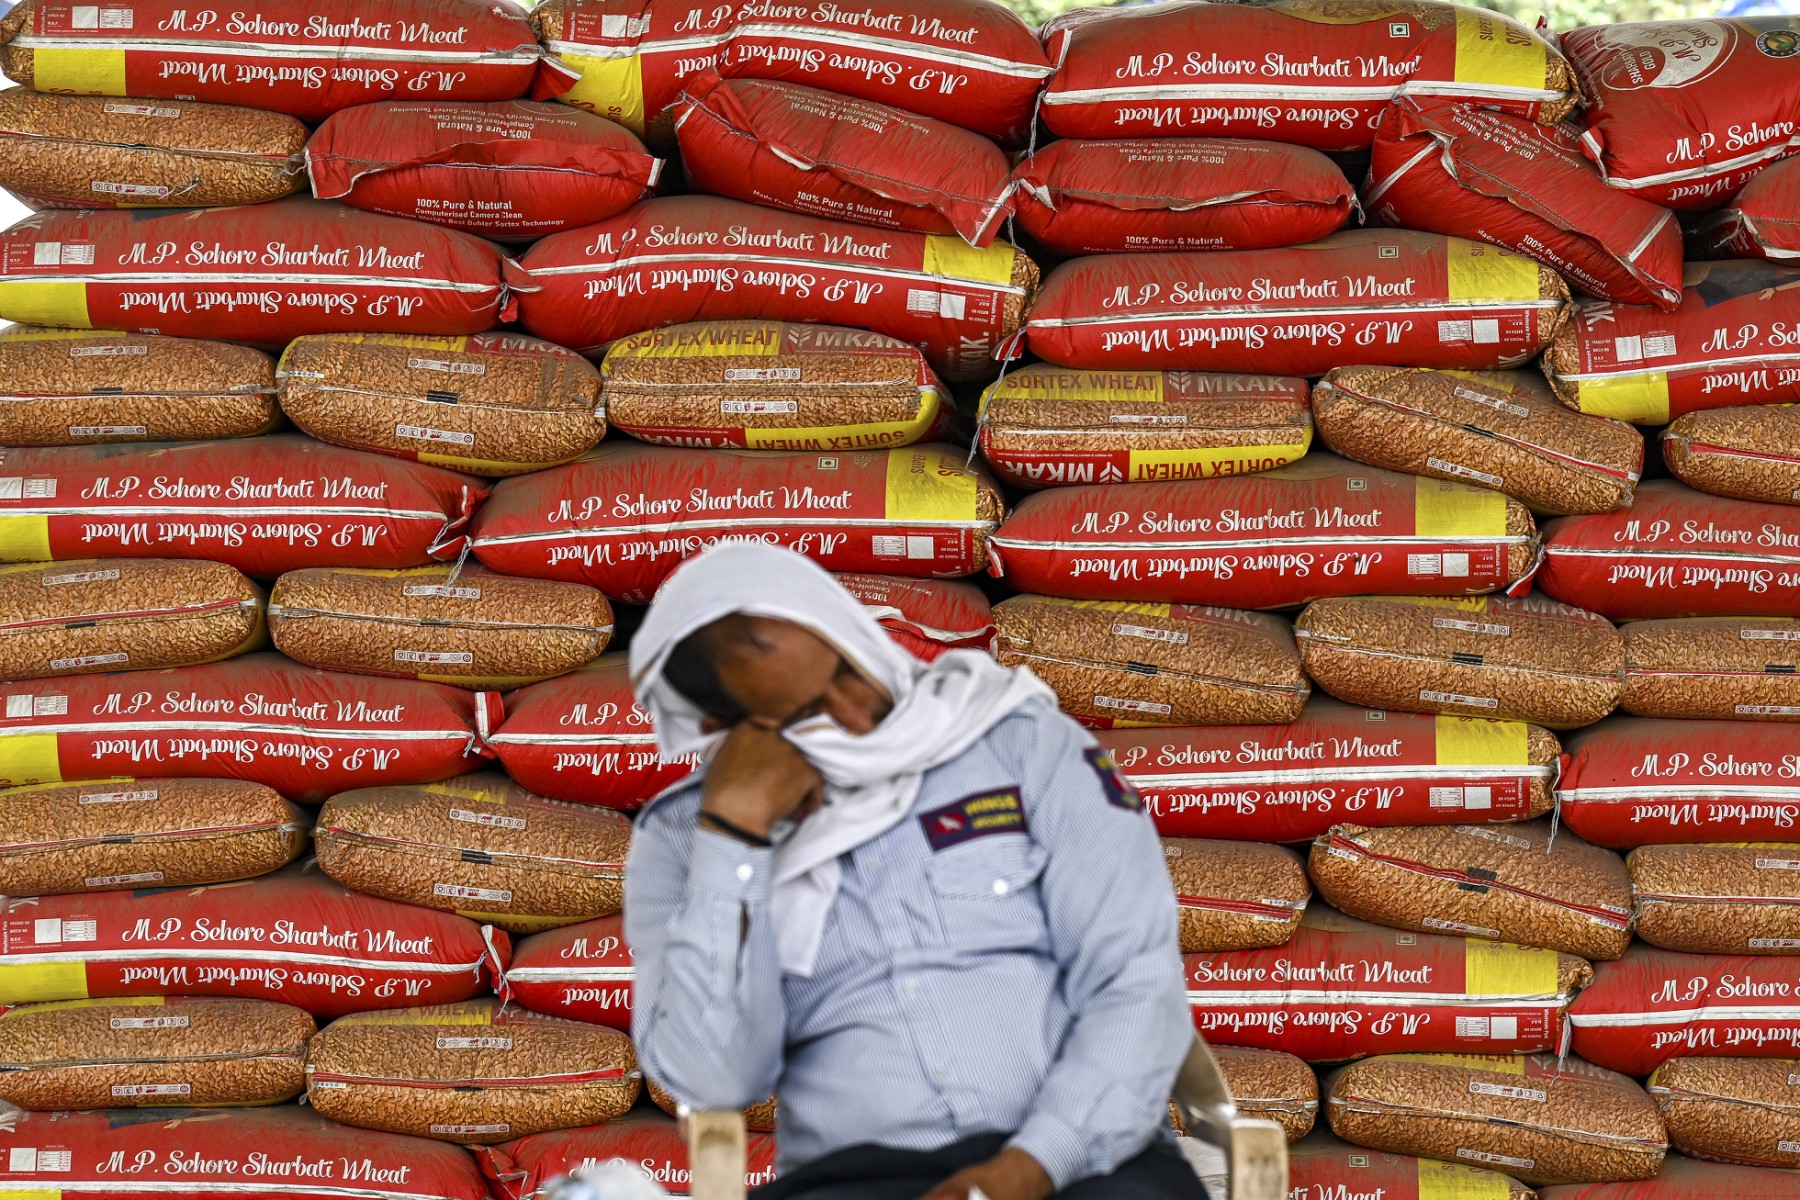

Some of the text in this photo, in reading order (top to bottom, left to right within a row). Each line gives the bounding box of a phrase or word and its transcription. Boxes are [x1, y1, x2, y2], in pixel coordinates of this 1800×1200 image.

[226, 12, 300, 36] Sehore
[304, 16, 391, 40] Sharbati
[397, 21, 468, 44] Wheat
[738, 0, 807, 20] Sehore
[812, 3, 902, 32] Sharbati
[910, 15, 978, 44] Wheat
[1183, 52, 1257, 76] Sehore
[1260, 53, 1352, 77] Sharbati
[1355, 56, 1422, 77] Wheat
[791, 102, 826, 117] Natural
[1114, 106, 1358, 128] Sehore Sharbati Wheat
[437, 122, 531, 139] 100% Pure & Natural
[1726, 122, 1793, 150] Sehore
[1128, 155, 1164, 163] Natural
[1177, 155, 1199, 163] Pure
[1202, 156, 1225, 164] 100%
[1668, 178, 1732, 200] Wheat
[415, 208, 468, 218] Computerised
[470, 211, 499, 219] Camera
[501, 211, 523, 219] Clean
[417, 198, 512, 210] 100% Pure & Natural
[793, 198, 845, 216] Computerised
[797, 191, 893, 217] 100% Pure & Natural
[522, 219, 564, 227] Technology
[645, 225, 719, 247] Sehore
[723, 226, 814, 251] Sharbati
[820, 233, 891, 259] Wheat
[1126, 235, 1223, 245] 100% Pure & Natural
[185, 242, 258, 266] Sehore
[261, 242, 350, 266] Sharbati
[355, 246, 424, 269] Wheat
[1523, 234, 1608, 289] 100% Pure & Natural
[584, 272, 646, 299] Wheat
[650, 268, 738, 292] Sharbati
[742, 270, 816, 298] Sehore
[1170, 282, 1244, 304] Sehore
[1248, 278, 1339, 301] Sharbati
[1343, 276, 1415, 296] Wheat
[627, 330, 700, 350] SORTEX
[709, 329, 777, 347] WHEAT
[1006, 373, 1295, 393] SORTEX WHEAT MKAK.
[1701, 370, 1770, 393] Wheat
[755, 430, 905, 450] SORTEX WHEAT
[1135, 462, 1201, 480] WHEAT
[1210, 457, 1288, 477] SORTEX
[148, 476, 222, 498] Sehore
[225, 476, 314, 500] Sharbati
[320, 477, 388, 500] Wheat
[612, 494, 682, 518] Sehore
[686, 488, 775, 512] Sharbati
[780, 486, 852, 509] Wheat
[1138, 511, 1213, 534] Sehore
[1216, 508, 1306, 532] Sharbati
[1314, 507, 1382, 527] Wheat
[1679, 520, 1753, 544] Sehore
[160, 691, 235, 714] Sehore
[239, 693, 328, 720] Sharbati
[334, 700, 404, 722] Wheat
[1157, 745, 1232, 766] Sehore
[1236, 740, 1325, 763] Sharbati
[1329, 737, 1402, 758] Wheat
[553, 753, 622, 776] Wheat
[1698, 753, 1774, 776] Sehore
[1631, 804, 1799, 827] Sharbati Wheat
[190, 918, 266, 942] Sehore
[270, 920, 359, 950] Sharbati
[363, 929, 432, 954] Wheat
[120, 967, 193, 985] Wheat
[198, 967, 288, 989] Sharbati
[293, 971, 365, 995] Sehore
[1194, 959, 1432, 984] Sehore Sharbati Wheat
[1716, 975, 1791, 998] Sehore
[562, 988, 633, 1010] Wheat
[1651, 1028, 1719, 1049] Wheat
[164, 1150, 239, 1174] Sehore
[242, 1152, 334, 1178] Sharbati
[340, 1158, 410, 1184] Wheat
